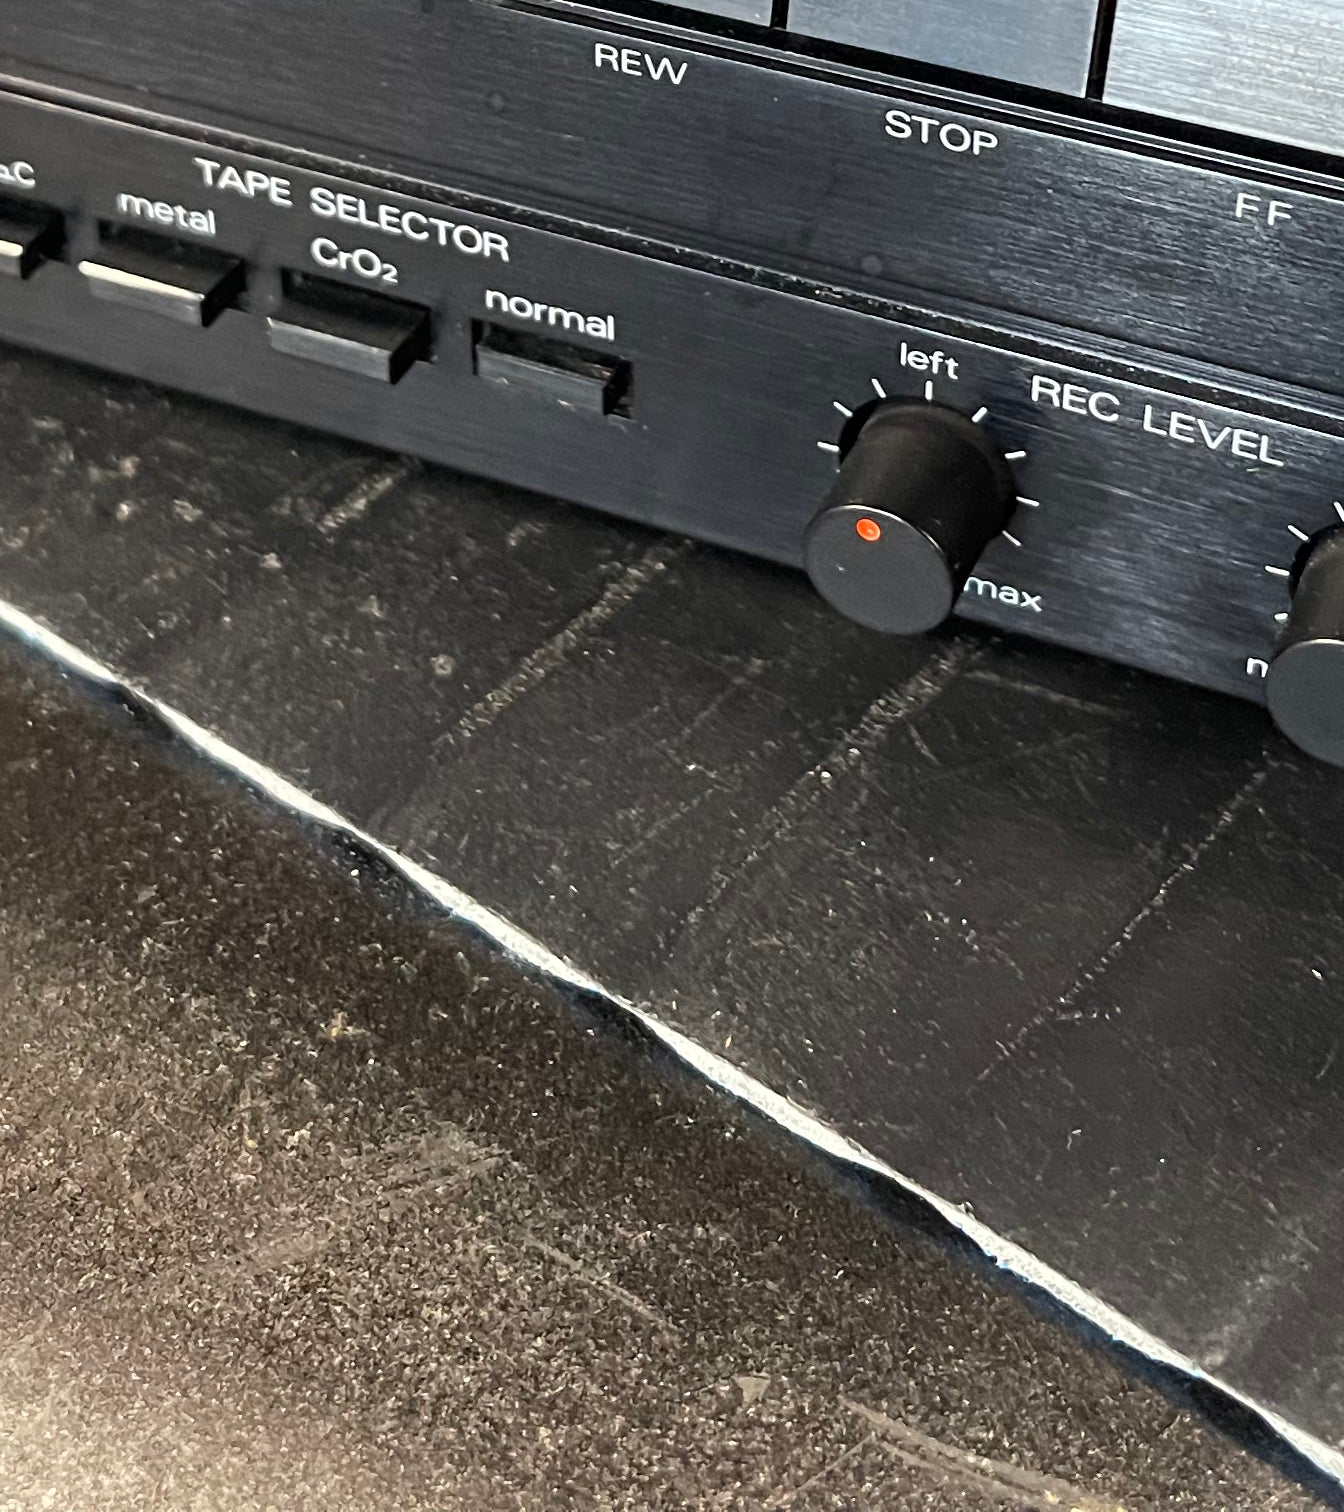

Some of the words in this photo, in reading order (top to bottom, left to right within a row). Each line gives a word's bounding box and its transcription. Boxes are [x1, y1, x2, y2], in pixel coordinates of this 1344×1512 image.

[593, 42, 689, 86] REW
[883, 110, 999, 157] STOP
[117, 189, 218, 235] metal
[193, 156, 295, 208] TAPE
[310, 187, 511, 262] SELECTOR
[484, 287, 617, 341] normal
[899, 342, 960, 381] left
[1030, 374, 1121, 424] REC
[1142, 403, 1285, 468] LEVEL
[963, 576, 1043, 613] max
